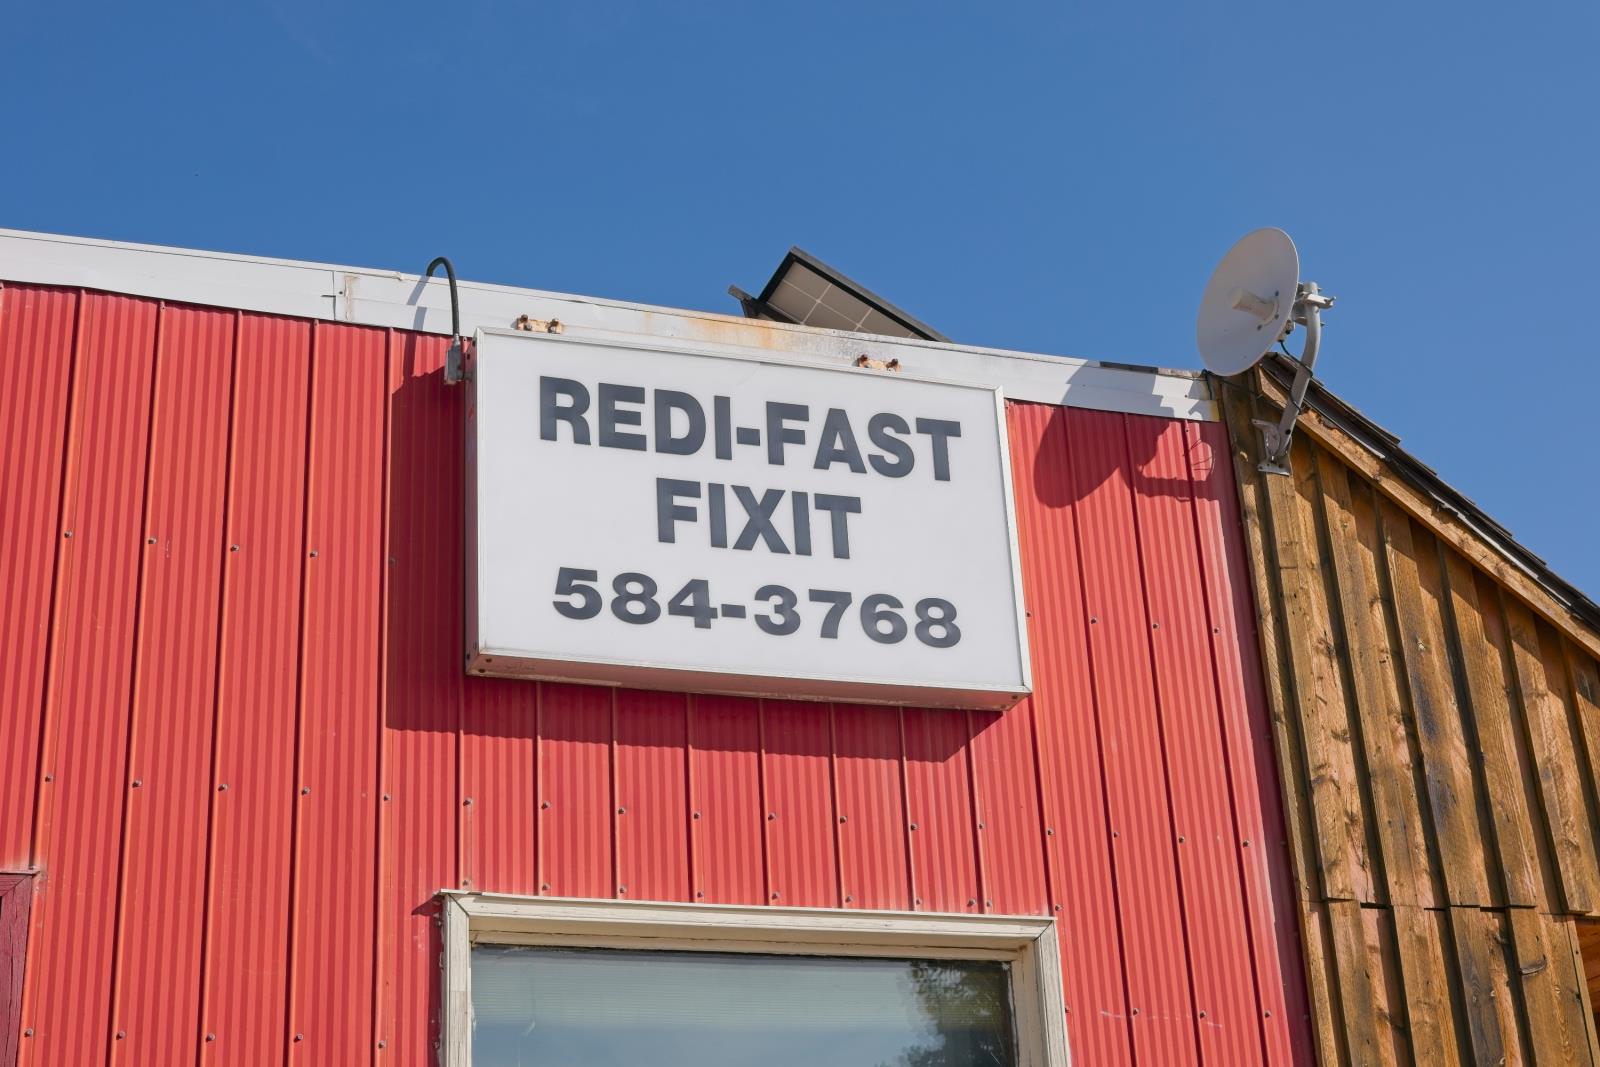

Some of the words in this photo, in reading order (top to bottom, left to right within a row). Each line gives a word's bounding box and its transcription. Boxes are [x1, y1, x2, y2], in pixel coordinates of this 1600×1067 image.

[540, 376, 961, 481] REDI-FAST
[656, 478, 861, 559] FIXIT
[553, 567, 961, 648] 584-3768
